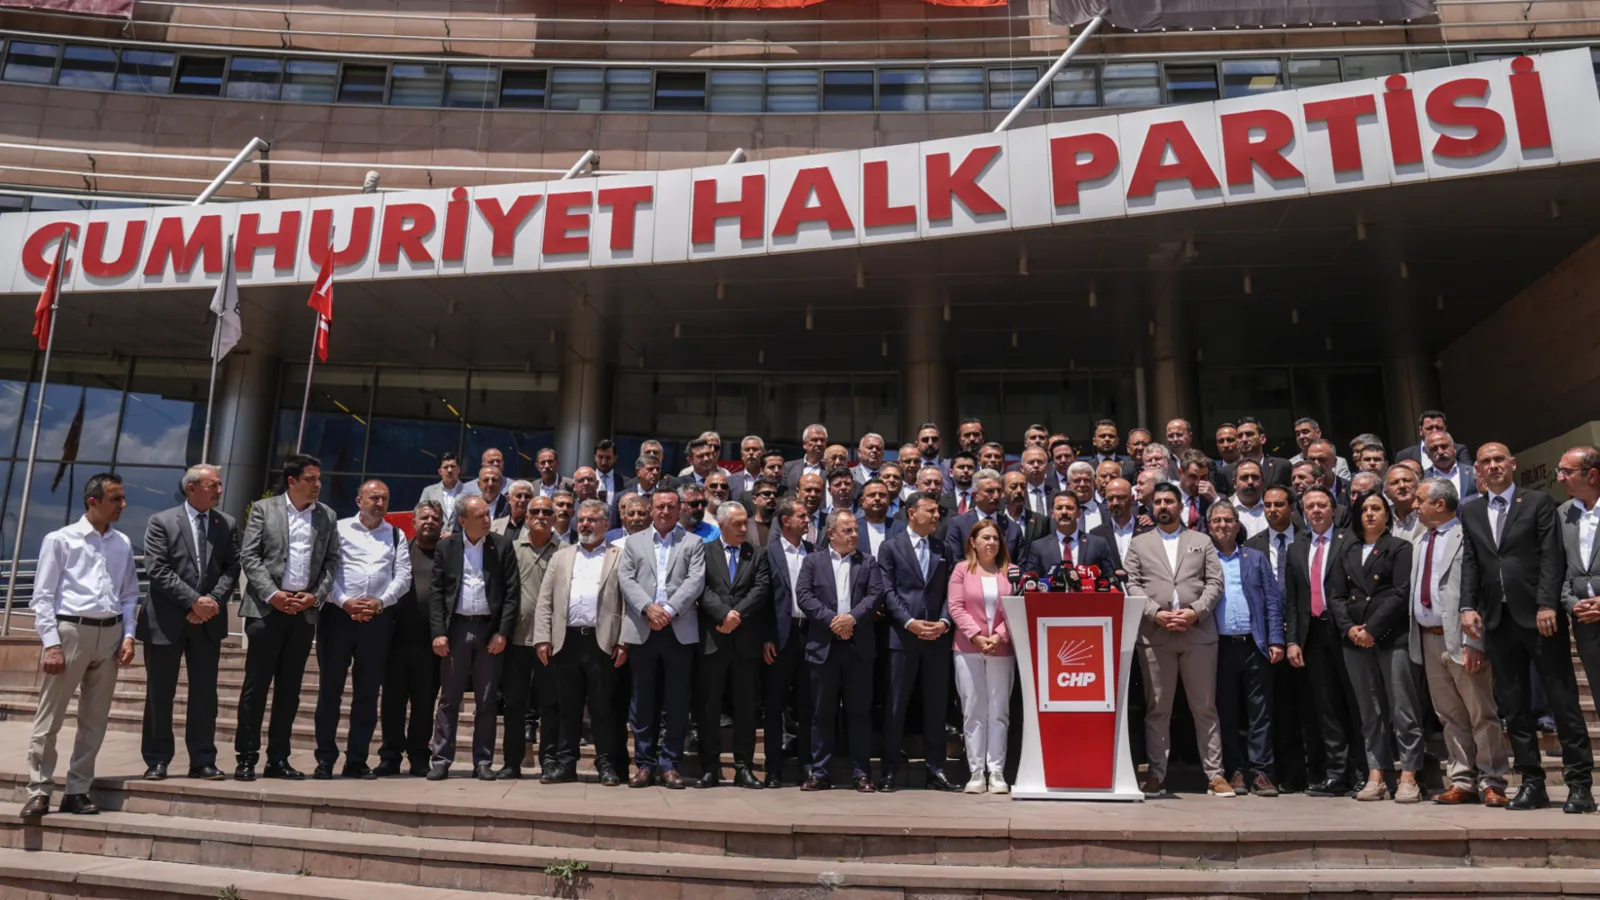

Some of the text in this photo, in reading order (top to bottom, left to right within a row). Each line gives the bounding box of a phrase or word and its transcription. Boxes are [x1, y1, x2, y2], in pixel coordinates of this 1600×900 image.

[22, 55, 1552, 279] CUMHURİYET HALK PARTİSİ
[1057, 672, 1096, 687] CHP
